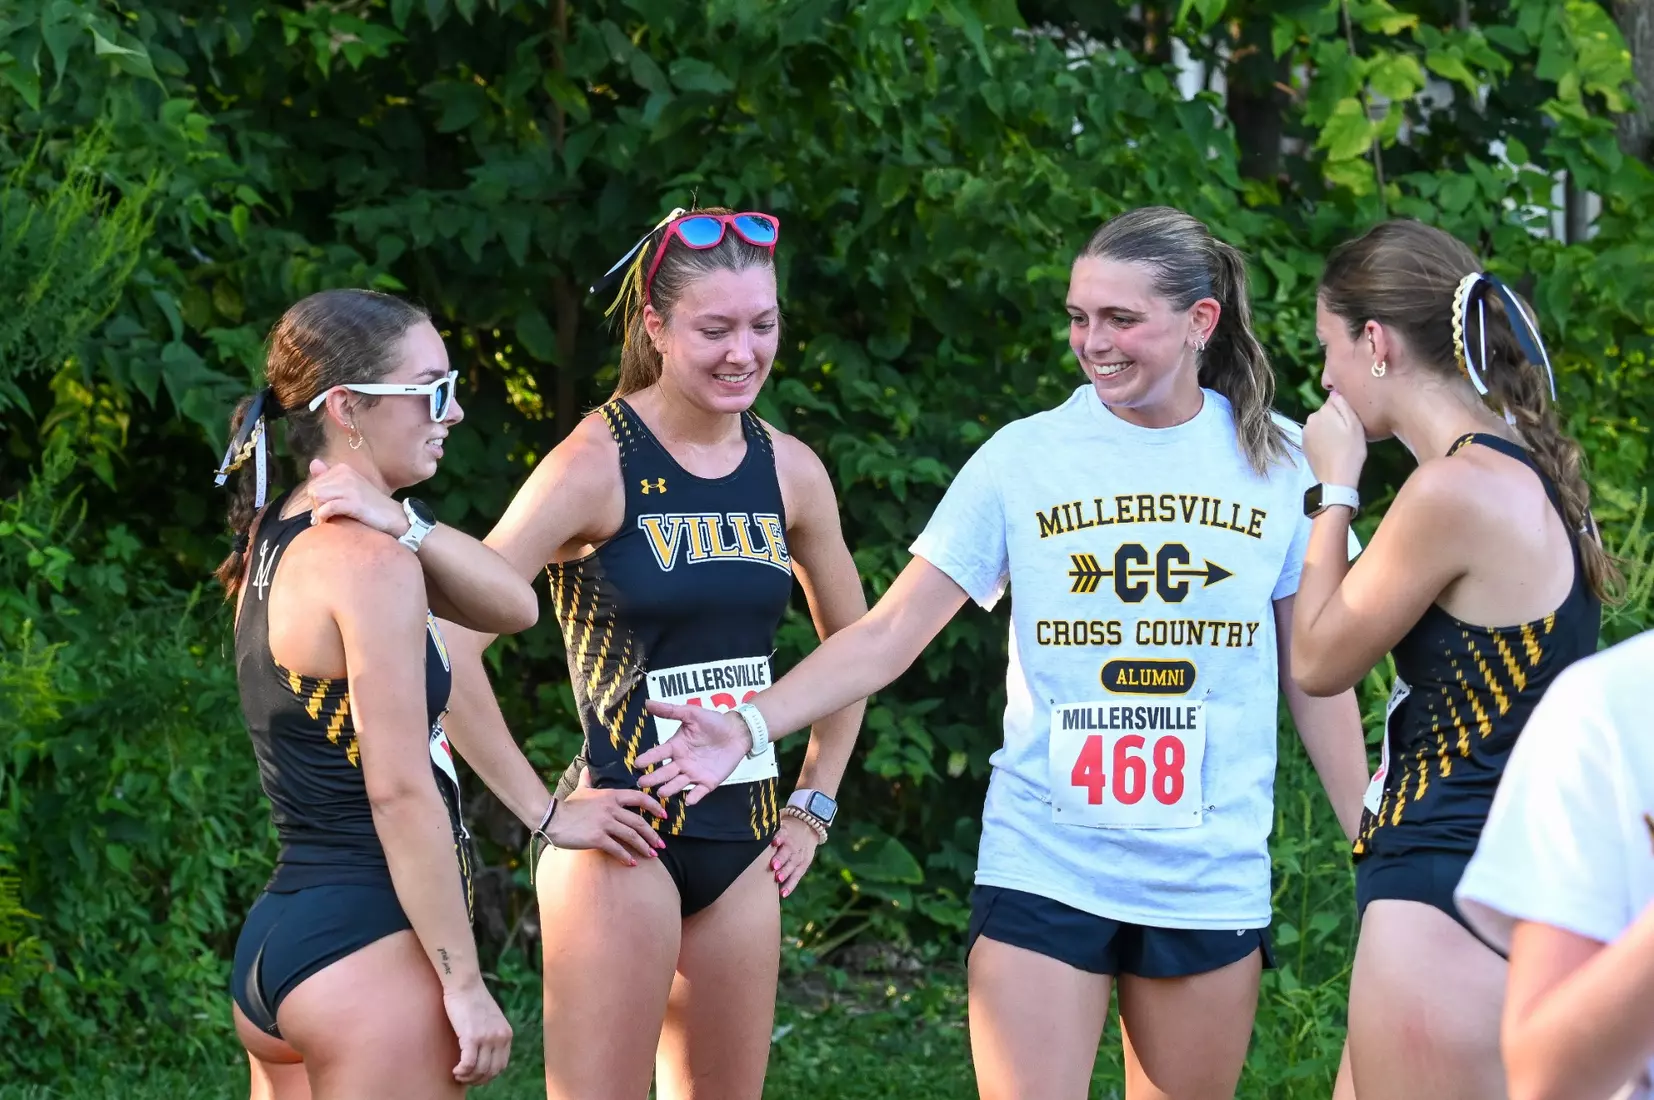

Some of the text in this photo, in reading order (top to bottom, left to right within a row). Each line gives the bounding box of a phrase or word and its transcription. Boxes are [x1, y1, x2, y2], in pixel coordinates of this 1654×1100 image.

[1036, 494, 1267, 540] MILLERSVILLE
[638, 512, 792, 575] VILLE
[1114, 543, 1190, 603] CC
[1036, 620, 1260, 648] CROSS COUNTRY
[659, 663, 766, 698] MILLERSVILLE
[1115, 668, 1185, 687] ALUMNI
[1062, 705, 1197, 731] MILLERSVILLE
[1071, 734, 1186, 806] 468
